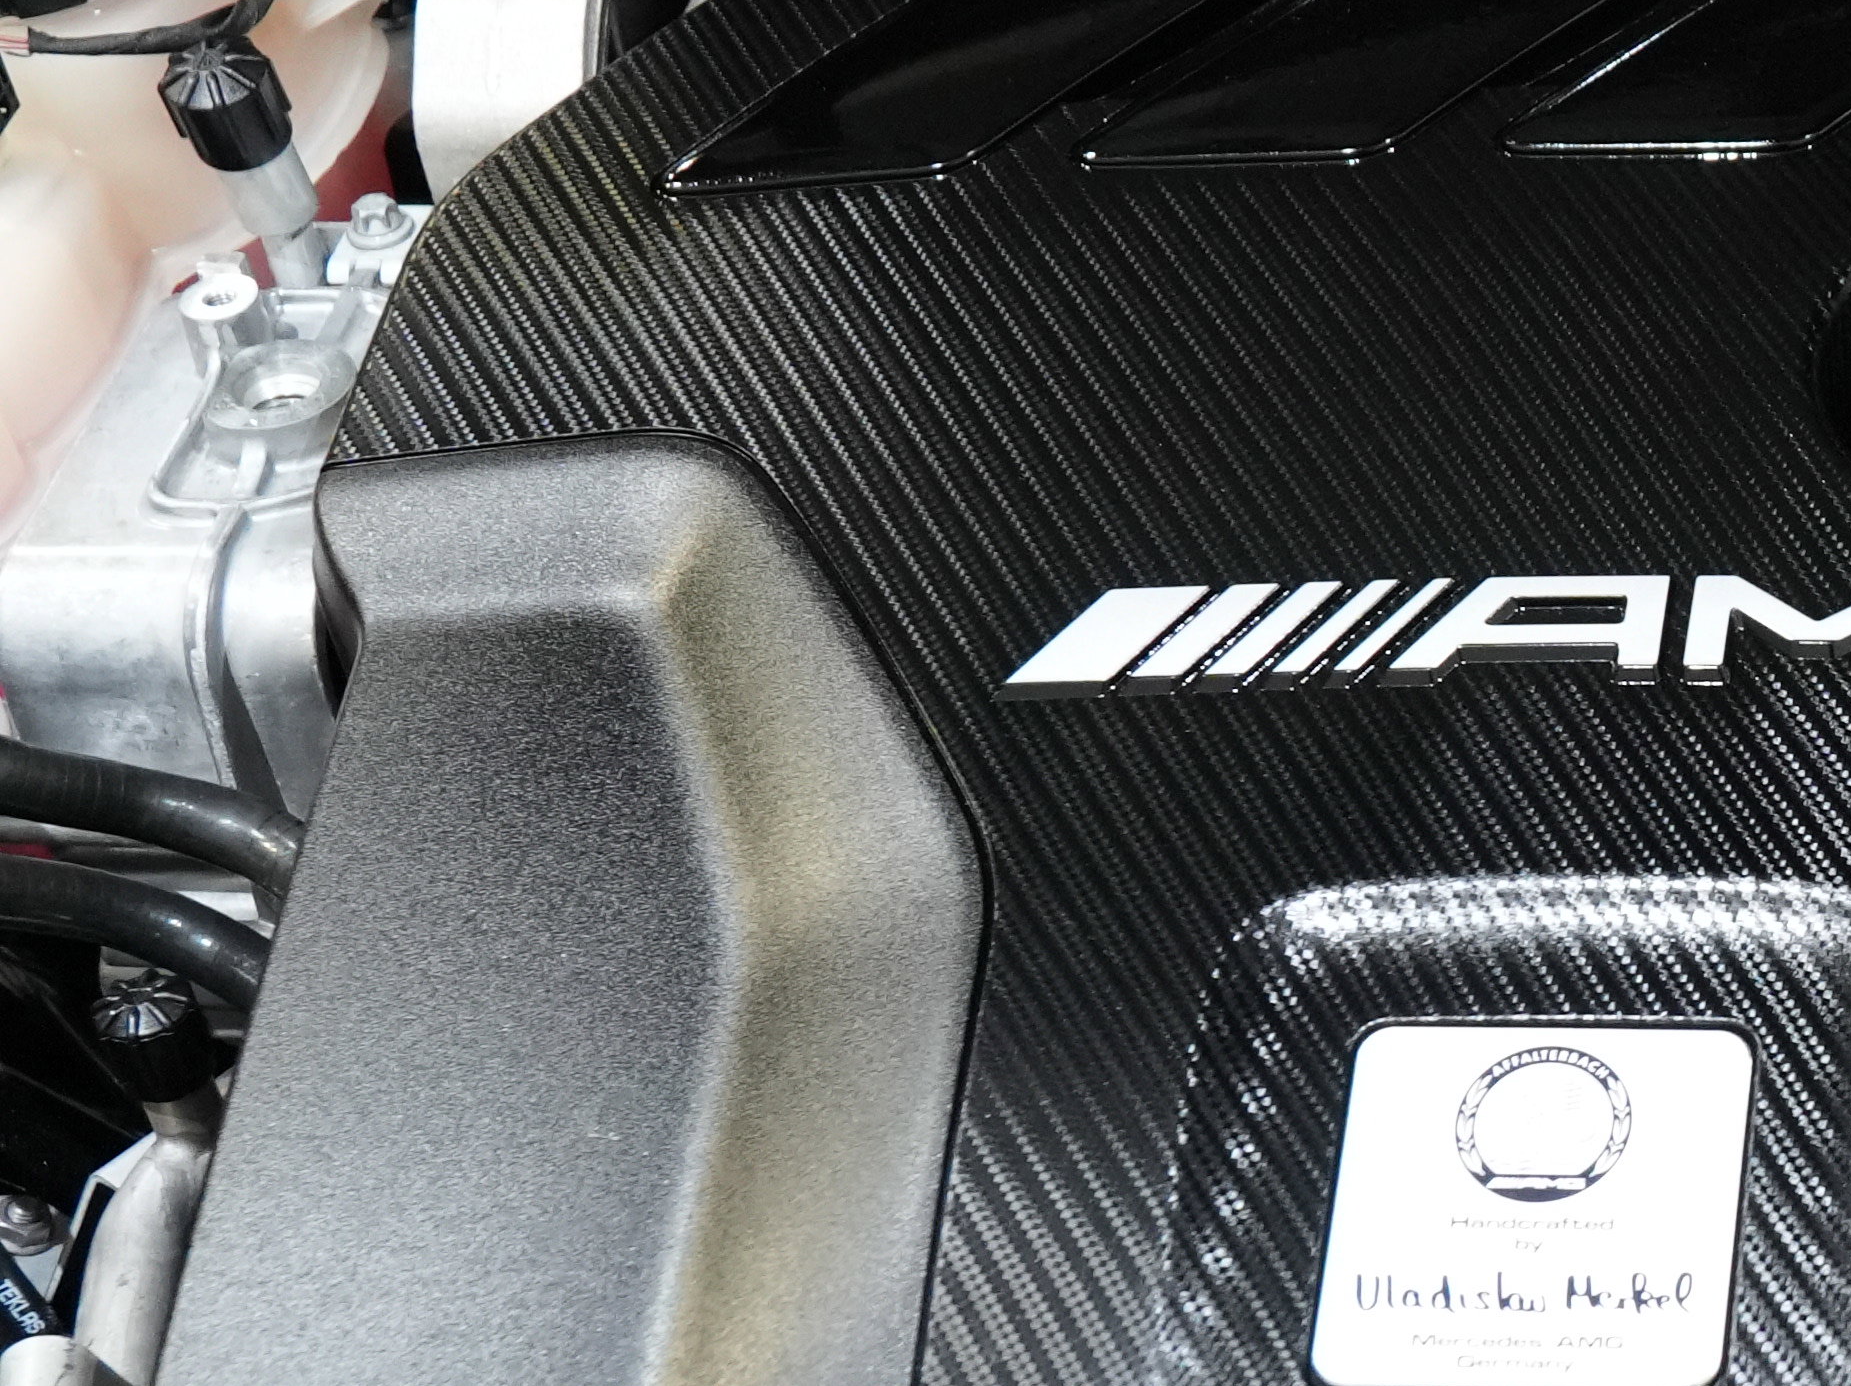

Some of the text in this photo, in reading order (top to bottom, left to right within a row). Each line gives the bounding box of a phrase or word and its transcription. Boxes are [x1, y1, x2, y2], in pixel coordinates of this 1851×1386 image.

[1491, 1048, 1610, 1081] AFFALTERBACH
[1450, 1216, 1615, 1232] Handcrafted
[1515, 1238, 1543, 1253] by
